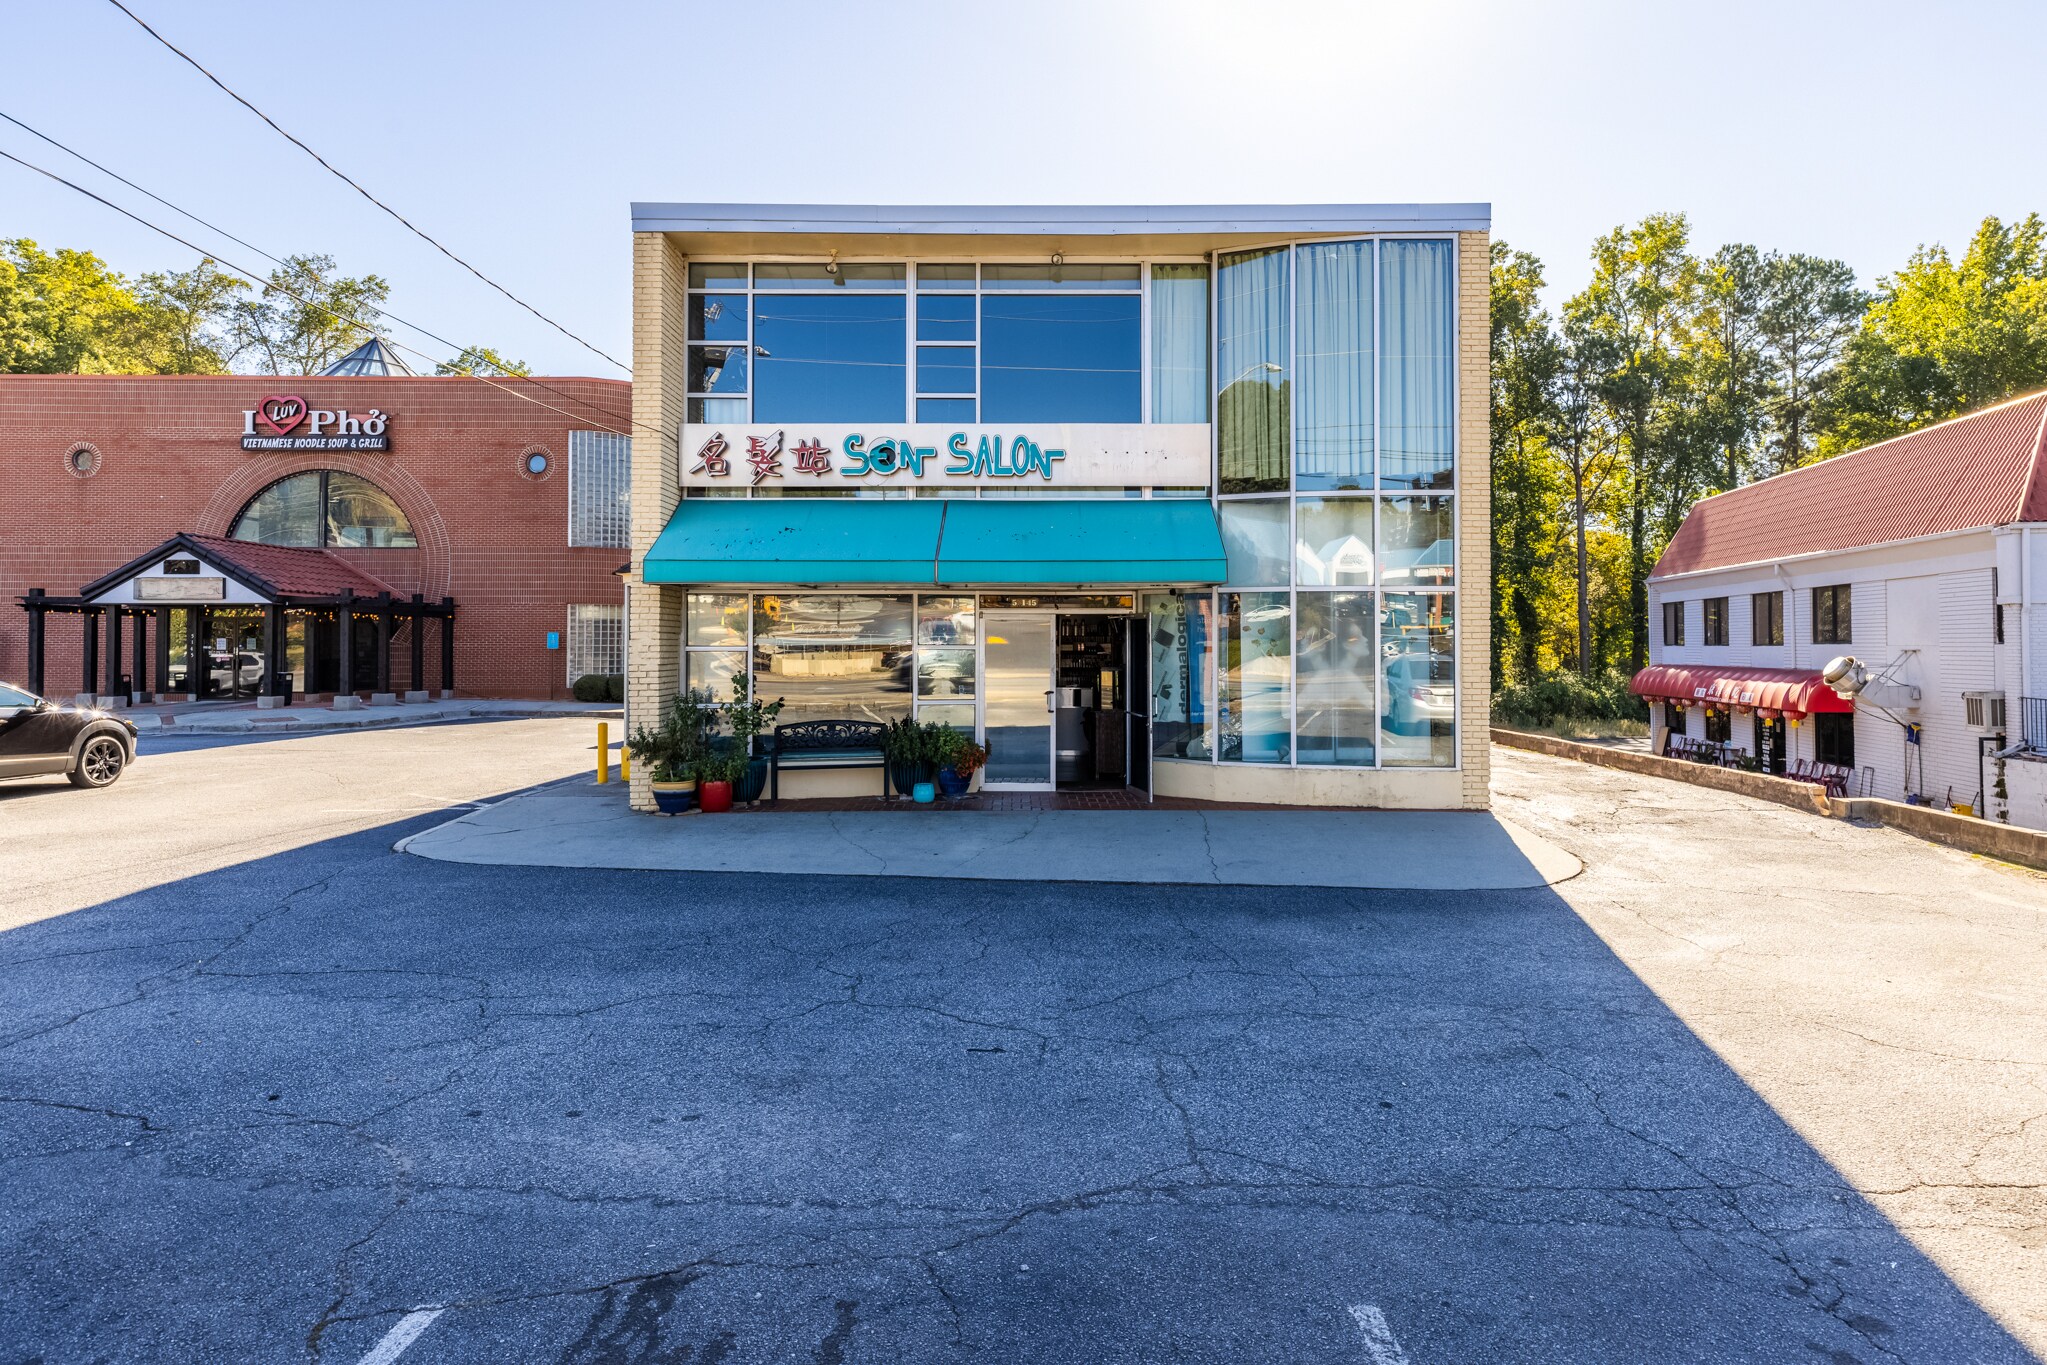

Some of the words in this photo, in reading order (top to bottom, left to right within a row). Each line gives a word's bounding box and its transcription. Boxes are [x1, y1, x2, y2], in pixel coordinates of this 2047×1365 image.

[241, 410, 257, 435] I
[272, 404, 298, 422] LUV
[243, 438, 293, 449] VIETNAMESE
[294, 438, 326, 448] NOODLE
[327, 438, 348, 447] SOUP
[350, 438, 357, 447] &
[358, 438, 383, 448] GRILL
[945, 432, 1066, 480] SALON
[1177, 594, 1187, 714] dermalogica
